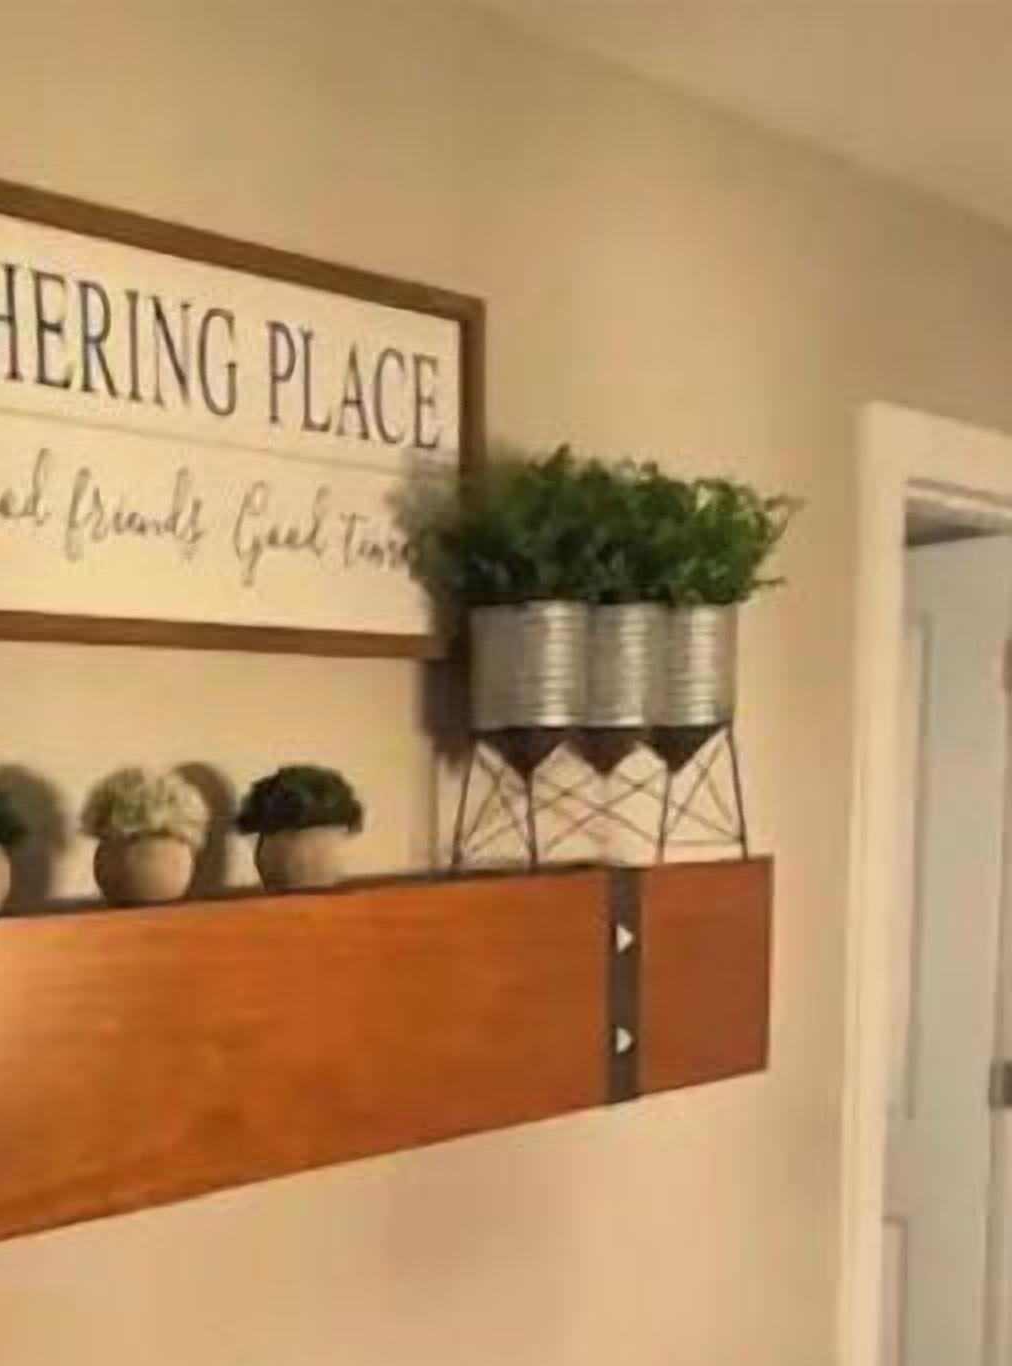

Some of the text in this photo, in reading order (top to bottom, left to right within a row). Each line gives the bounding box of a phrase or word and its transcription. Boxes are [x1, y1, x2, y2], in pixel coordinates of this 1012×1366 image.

[265, 319, 443, 450] PLACE
[63, 466, 206, 562] friends
[232, 480, 330, 587] Good
